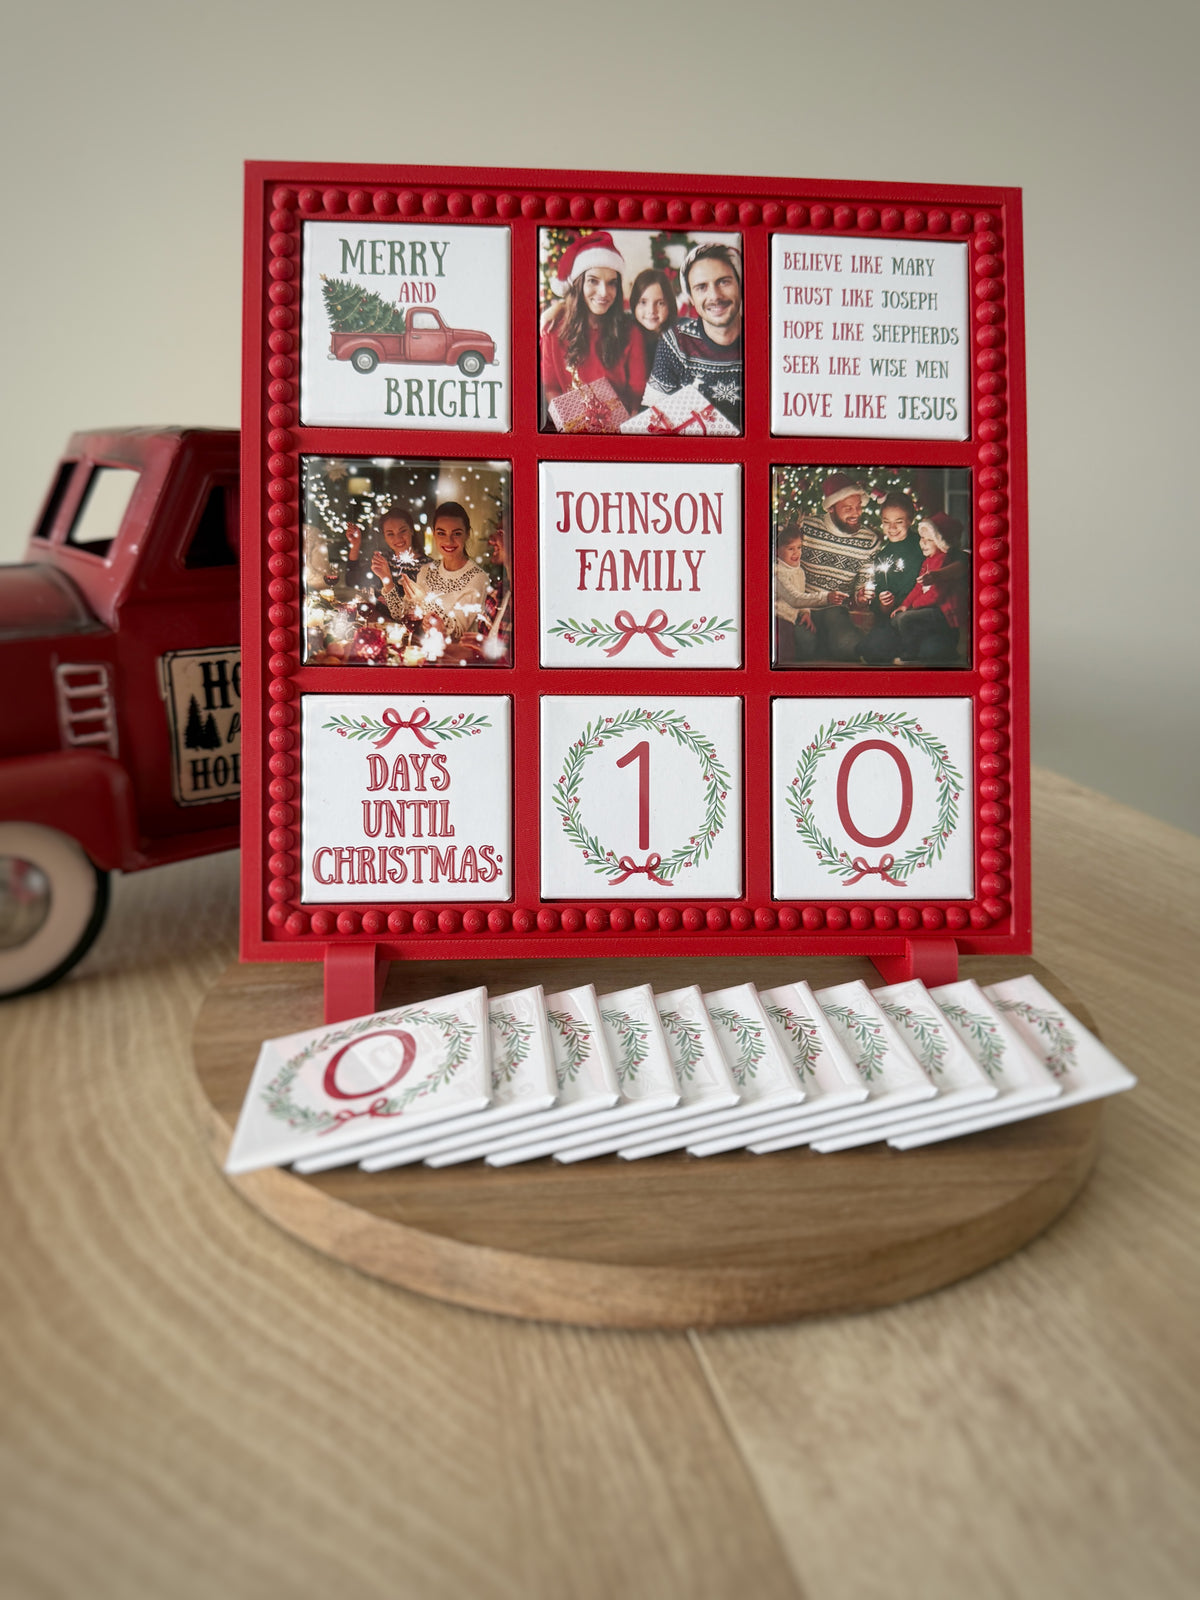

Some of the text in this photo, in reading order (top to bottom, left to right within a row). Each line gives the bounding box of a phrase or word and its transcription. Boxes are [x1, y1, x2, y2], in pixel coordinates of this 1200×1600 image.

[339, 239, 450, 277] MERRY
[784, 252, 934, 276] BELIEVE LIKE MARY
[398, 282, 436, 303] AND
[783, 286, 937, 310] TRUST LIKE JOSEPH
[784, 321, 959, 345] HOPE LIKE SHEPHERDS
[783, 355, 948, 378] SEEK LIKE WISE MEN
[384, 375, 502, 418] BRIGHT
[783, 392, 957, 421] LOVE LIKE JESUS
[556, 491, 723, 534] JOHNSON
[575, 549, 706, 591] FAMILY
[366, 754, 450, 791] DAYS
[616, 741, 650, 851] 1
[836, 739, 914, 848] 0
[361, 800, 455, 838] UNTIL
[312, 845, 503, 885] CHRISTMAS:
